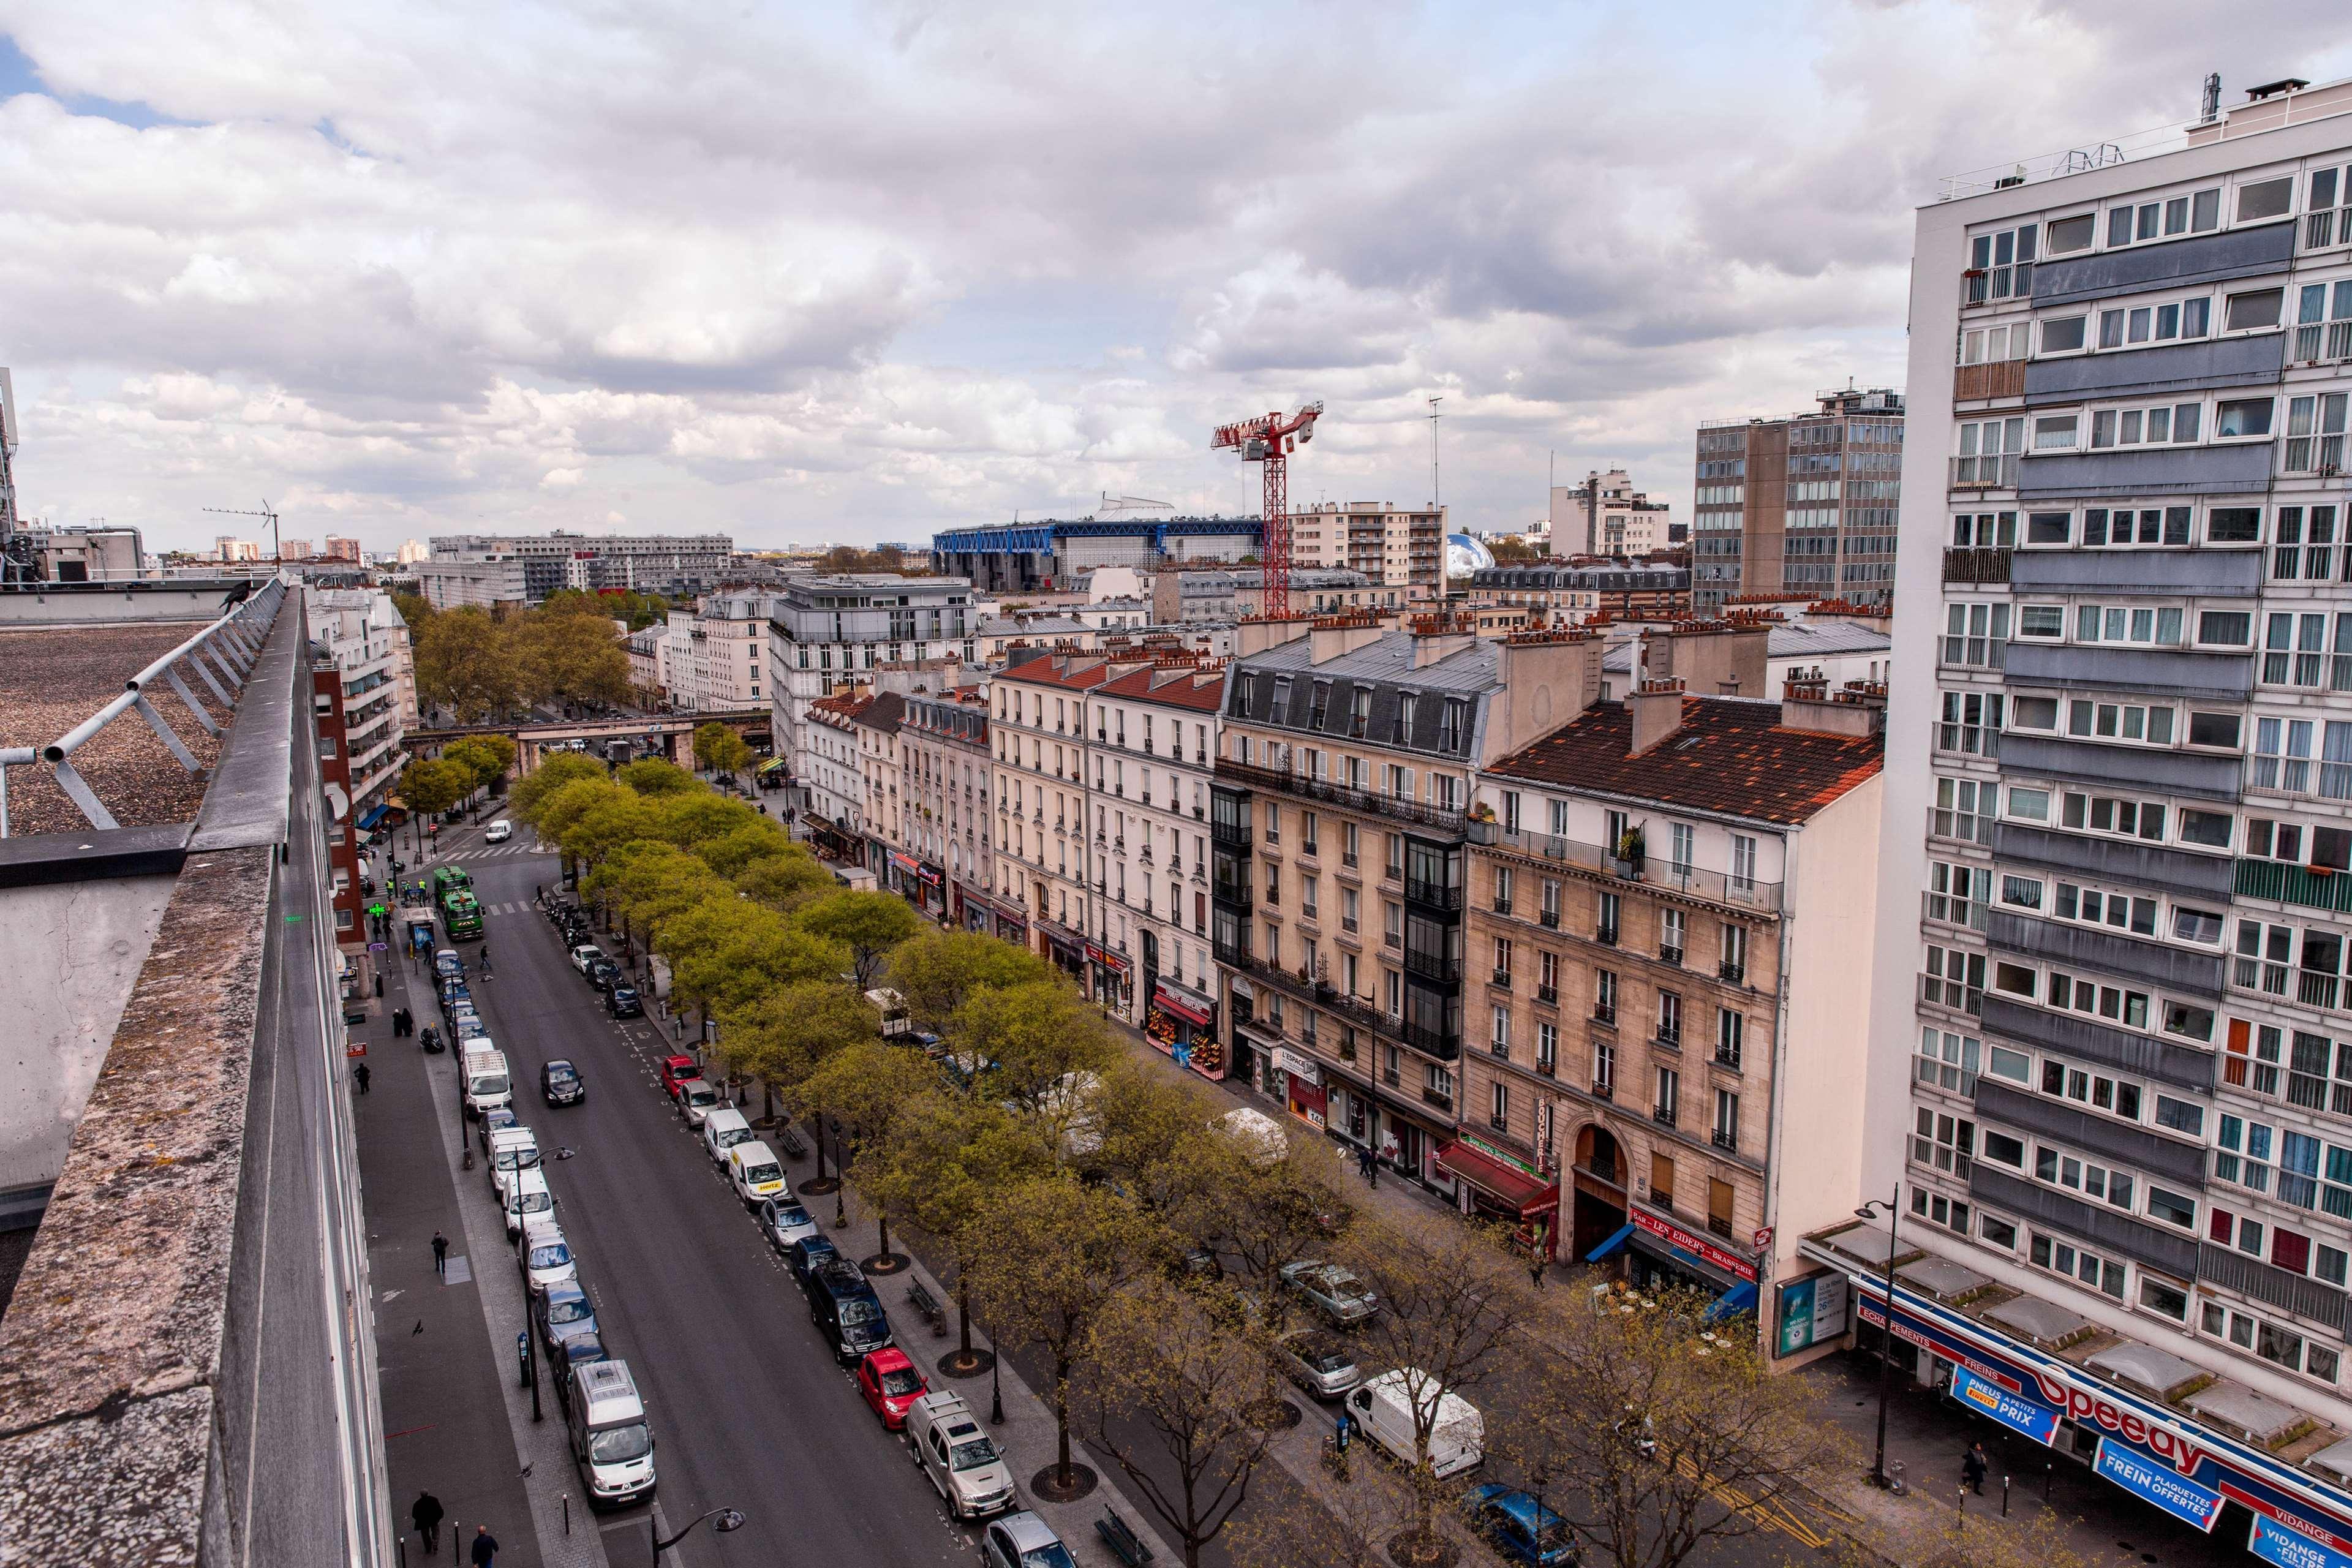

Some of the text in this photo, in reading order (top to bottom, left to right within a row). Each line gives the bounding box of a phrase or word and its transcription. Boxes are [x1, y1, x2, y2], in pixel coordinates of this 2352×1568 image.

[1283, 1051, 1305, 1069] L'ESPACE
[1311, 1113, 1323, 1126] 144
[1633, 1212, 1646, 1224] BAR
[1653, 1221, 1670, 1235] LES
[1673, 1230, 1706, 1253] EIDERS
[1712, 1251, 1754, 1276] BRASSERIE
[1818, 1303, 1827, 1312] 26
[1863, 1308, 1930, 1347] ECHAPEMENTS
[1965, 1357, 1999, 1380] FREINS
[1969, 1378, 2002, 1400] PNEUS
[1969, 1389, 1995, 1406] PIRELLI
[2011, 1399, 2037, 1415] PETITS
[2035, 1363, 2205, 1477] Speedy
[2106, 1455, 2152, 1488] FREIN
[2155, 1475, 2211, 1508] PLAQUETTES
[935, 1509, 966, 1551] PAYANT
[2275, 1509, 2333, 1545] VIDANGE
[2266, 1528, 2326, 1566] VIDANGE
